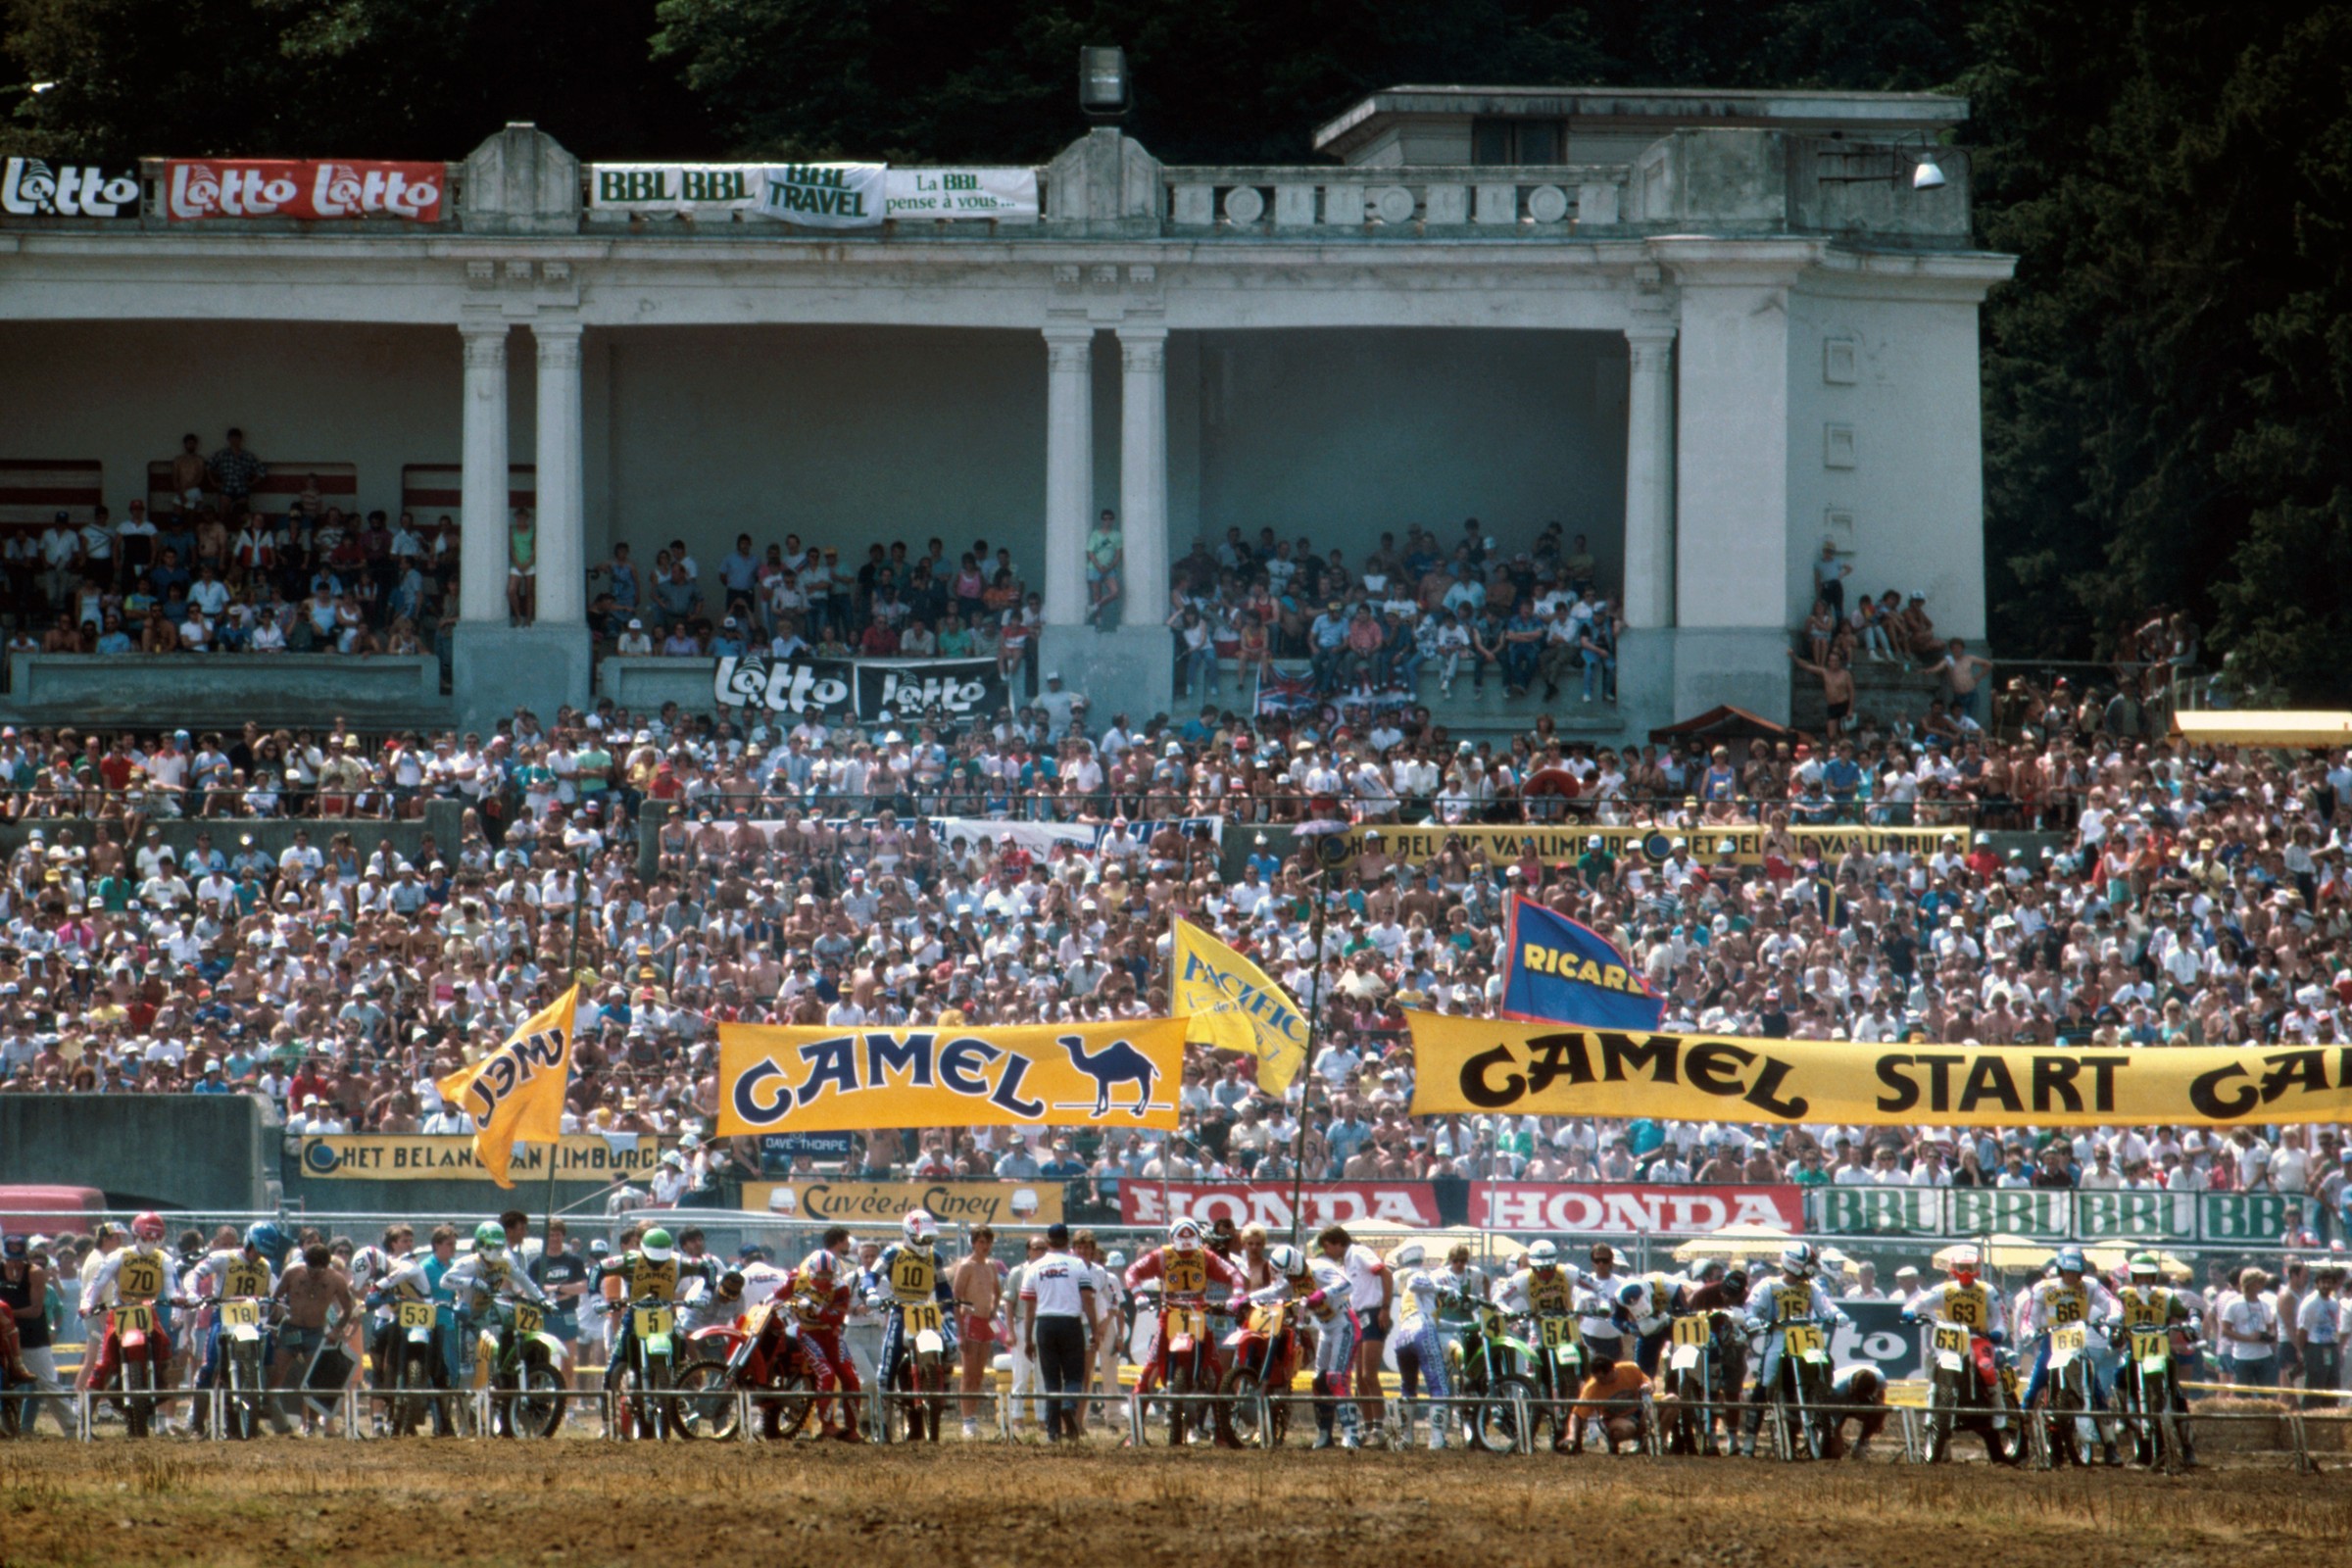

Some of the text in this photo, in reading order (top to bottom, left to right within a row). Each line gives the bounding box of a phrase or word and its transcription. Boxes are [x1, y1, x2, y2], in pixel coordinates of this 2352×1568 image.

[2, 158, 139, 217] Lotto
[600, 171, 676, 202] BBL
[682, 171, 756, 201] BBL
[786, 166, 852, 191] BBL
[916, 173, 983, 191] La BBL
[170, 164, 297, 218] Lotto
[312, 164, 439, 218] Lotto
[769, 181, 868, 218] TRAVEL
[886, 196, 936, 215] pense
[942, 193, 952, 209] à
[714, 655, 848, 713] Lotto
[1349, 835, 1389, 856] HT
[1492, 835, 1531, 856] VA
[1183, 951, 1309, 1042] PACIFIC
[733, 1033, 1046, 1124] CAMEL
[1459, 1033, 2352, 1119] CAMEL START CA
[765, 1137, 848, 1152] DAVE THORPE
[343, 1147, 384, 1168] HET
[510, 1147, 542, 1169] AN
[555, 1147, 654, 1169] IMBURG
[803, 1185, 1003, 1223] Cuvée de Ciney
[1130, 1187, 1430, 1227] HONDA
[1481, 1192, 1792, 1231] HONDA
[1826, 1190, 1937, 1231] BBL
[1957, 1191, 2069, 1234] BBL
[2081, 1192, 2191, 1236] BBL
[2208, 1197, 2303, 1238] BB
[636, 1271, 672, 1283] CAMEL
[903, 1265, 923, 1288] 10
[1166, 1259, 1203, 1271] CAMEL
[129, 1269, 154, 1292] 70
[235, 1276, 257, 1297] 18
[1183, 1270, 1191, 1290] 1
[1531, 1284, 1565, 1298] CAMEL
[1945, 1290, 1984, 1304] CAMEL
[116, 1307, 148, 1334] 70
[231, 1307, 252, 1323] 18
[405, 1306, 429, 1325] 53
[519, 1307, 539, 1333] 22
[1784, 1299, 1803, 1321] 15
[1952, 1303, 1976, 1323] 63
[2055, 1301, 2081, 1323] 66
[648, 1311, 659, 1334] 5
[1545, 1320, 1572, 1347] 54
[1681, 1321, 1700, 1345] 11
[1789, 1329, 1819, 1354] 15
[1936, 1328, 1959, 1351] 63
[2058, 1334, 2081, 1350] 66
[2139, 1336, 2160, 1357] 14
